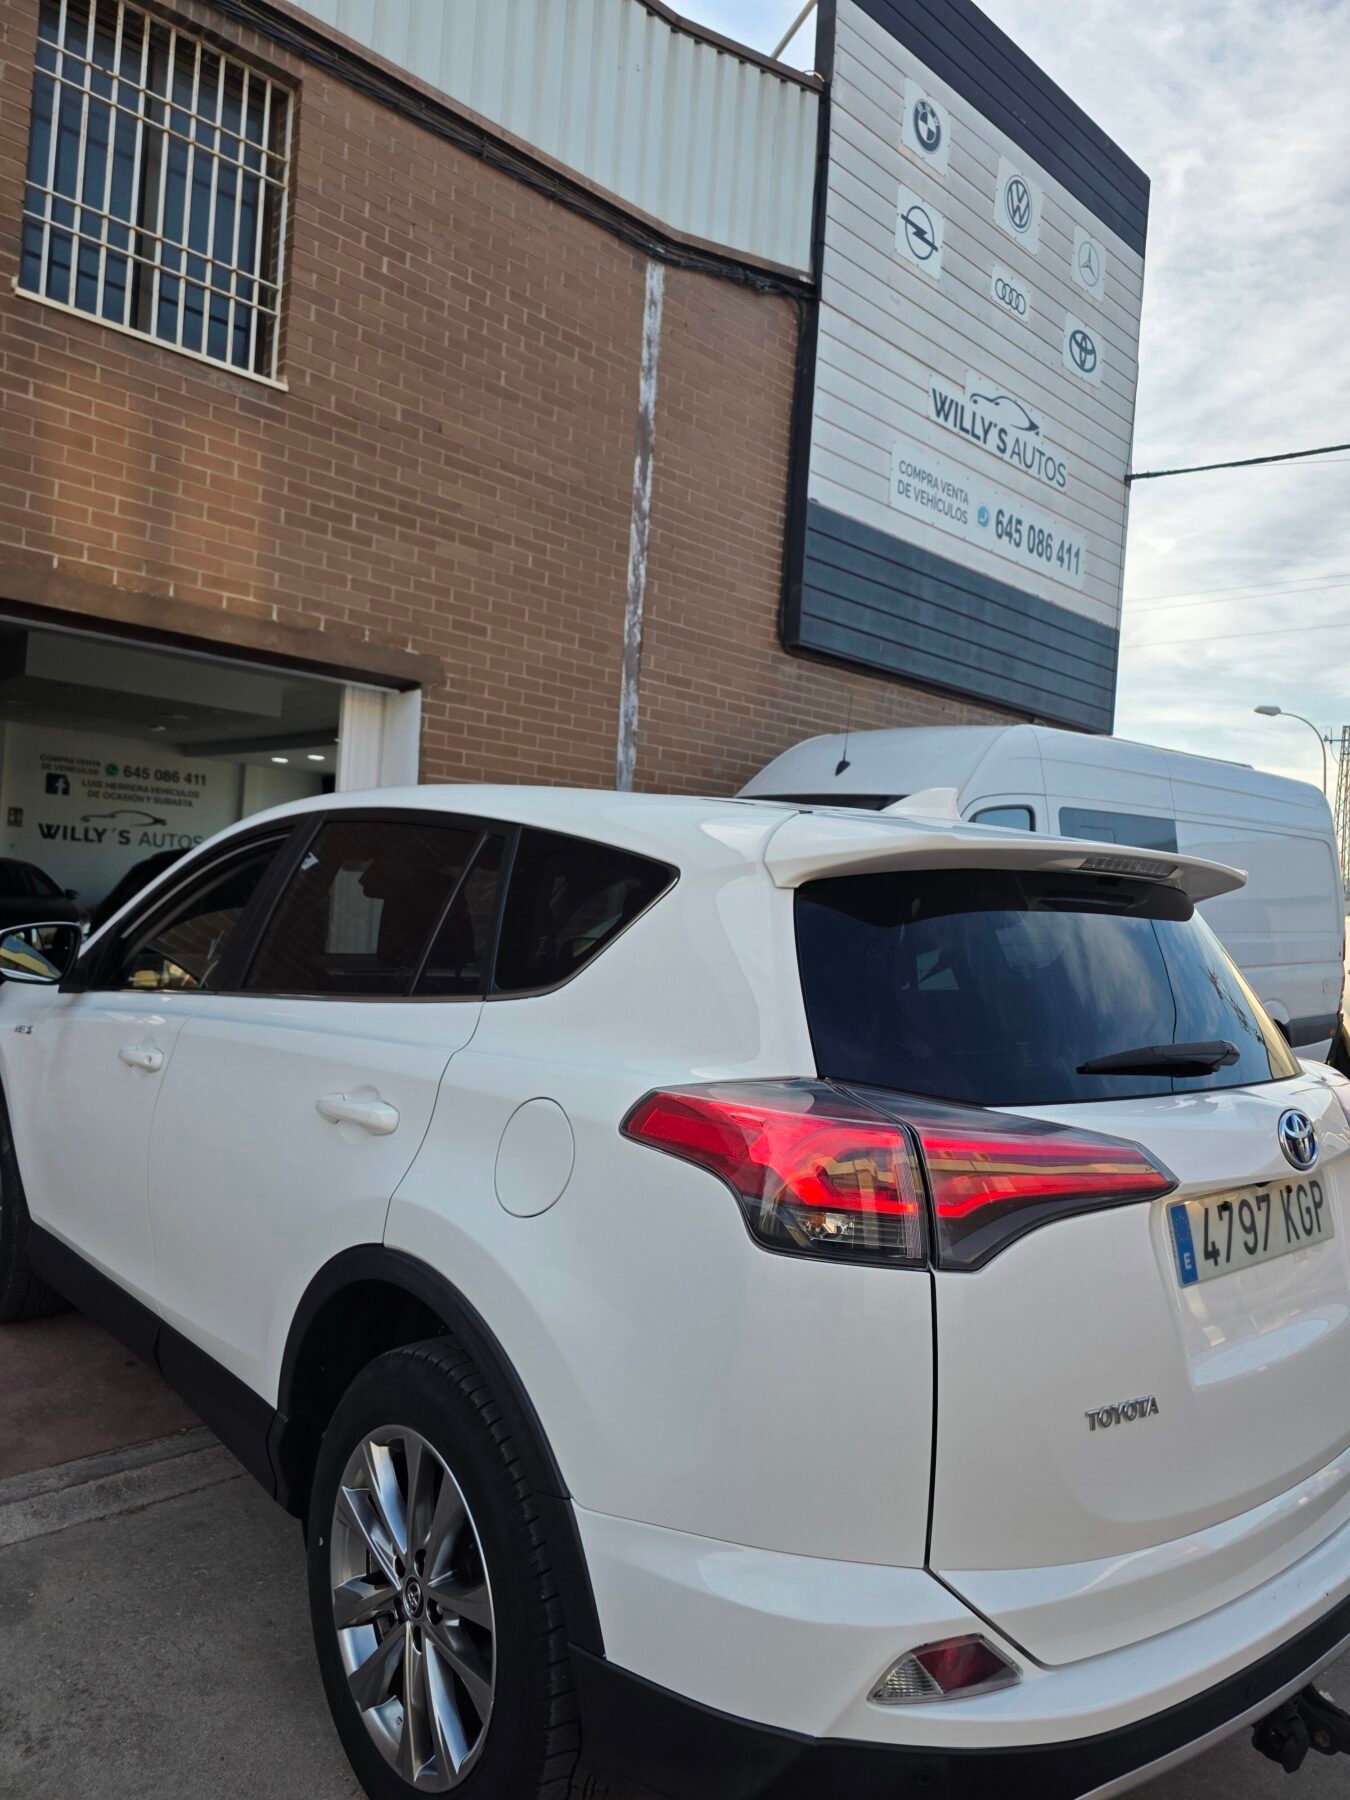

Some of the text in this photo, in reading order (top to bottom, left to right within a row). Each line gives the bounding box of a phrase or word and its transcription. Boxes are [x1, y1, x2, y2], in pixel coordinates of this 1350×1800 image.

[1010, 437, 1067, 488] AUTOS
[897, 479, 912, 499] DE
[898, 460, 969, 505] COMPRA VENTA
[995, 508, 1081, 576] 645 086 411
[81, 778, 104, 788] LUIS
[105, 782, 149, 793] HERRERA
[123, 765, 207, 786] 645 086 411
[87, 789, 100, 798] DE
[153, 798, 193, 807] SUBASTA
[1203, 1193, 1271, 1267] 4797
[1280, 1180, 1323, 1243] KGP
[1183, 1253, 1192, 1270] E
[1085, 1395, 1159, 1431] TOYOTA
